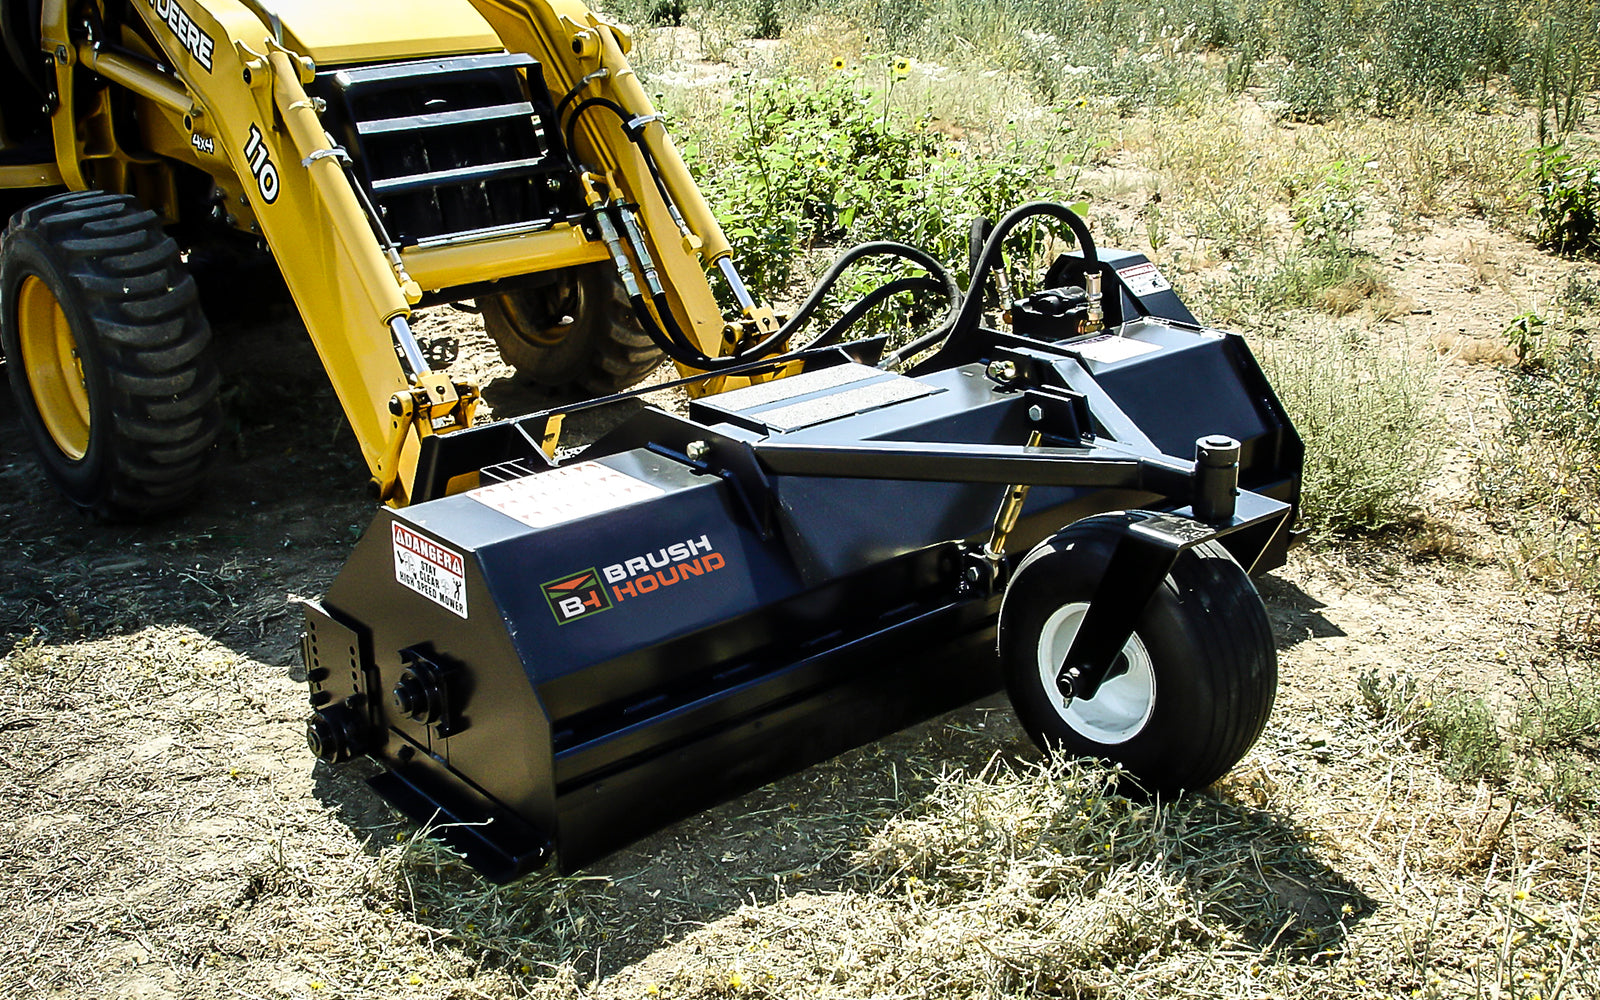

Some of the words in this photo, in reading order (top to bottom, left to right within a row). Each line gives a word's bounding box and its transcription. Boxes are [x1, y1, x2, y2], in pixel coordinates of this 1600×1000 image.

[245, 125, 279, 202] 110
[404, 530, 452, 571] DANGER
[420, 560, 437, 577] STAY
[602, 534, 713, 584] BRUSH
[399, 570, 415, 587] HIGH
[416, 580, 437, 599] SPEED
[439, 592, 464, 614] MOWER
[419, 570, 440, 590] CLEAR
[611, 552, 726, 602] HOUND
